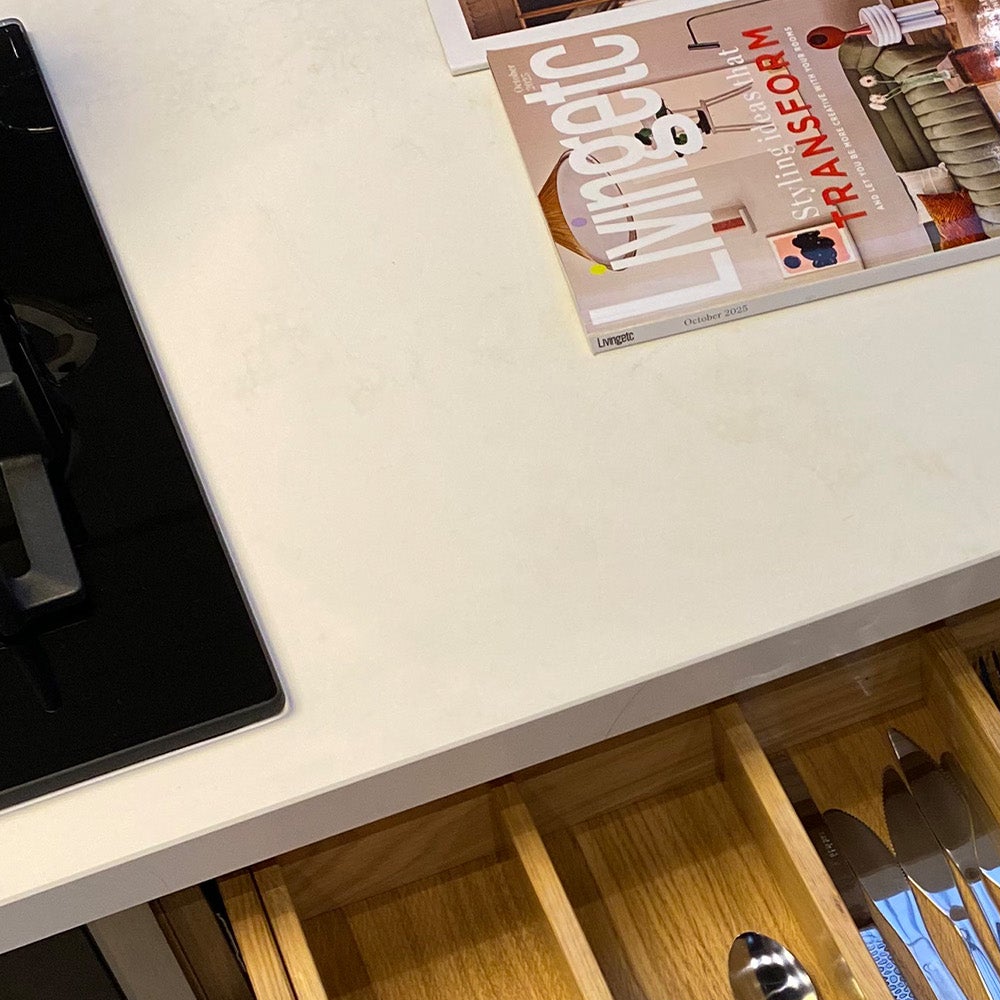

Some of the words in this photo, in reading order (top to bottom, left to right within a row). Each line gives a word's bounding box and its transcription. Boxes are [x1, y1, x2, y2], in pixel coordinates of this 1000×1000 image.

[784, 26, 802, 51] ROOMS
[719, 46, 753, 88] that
[797, 52, 812, 72] YOUR
[807, 72, 822, 91] WITH
[743, 90, 781, 143] ideas
[818, 92, 841, 126] CREATIVE
[742, 25, 867, 228] TRANSFORM
[835, 126, 852, 147] MORE
[846, 148, 858, 159] BE
[523, 34, 742, 325] Livingetc
[853, 160, 867, 176] YOU
[768, 142, 820, 221] Styling
[862, 178, 875, 192] LET
[871, 193, 885, 210] AND
[597, 331, 634, 348] Livingetc
[683, 312, 722, 326] October
[725, 304, 748, 316] 2025
